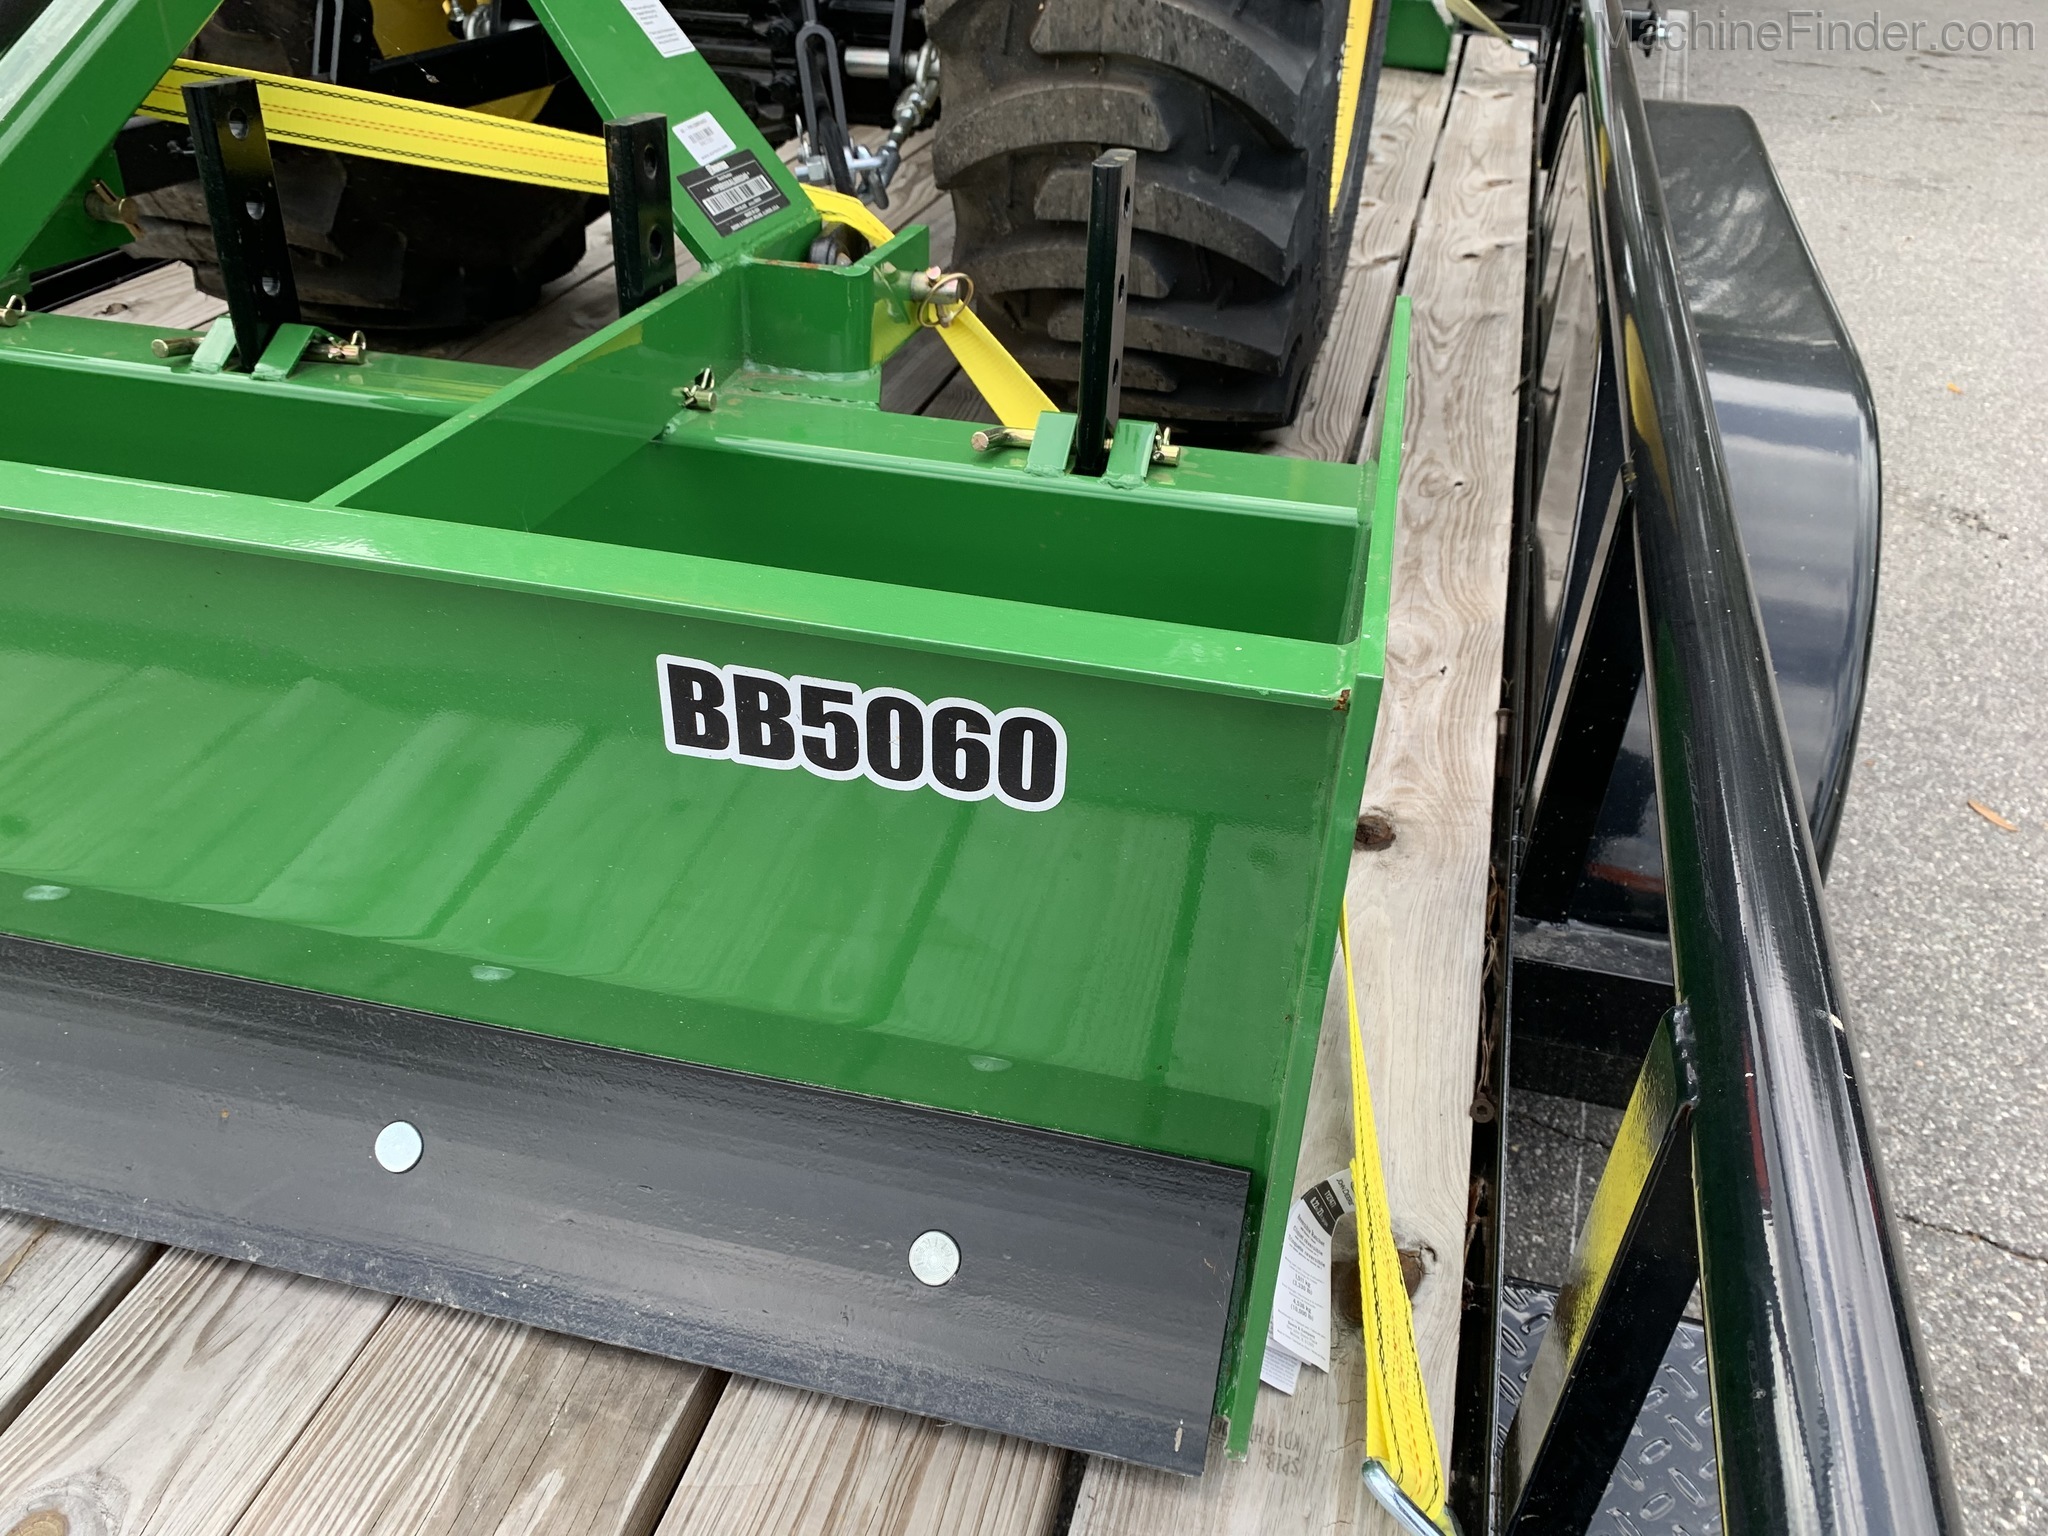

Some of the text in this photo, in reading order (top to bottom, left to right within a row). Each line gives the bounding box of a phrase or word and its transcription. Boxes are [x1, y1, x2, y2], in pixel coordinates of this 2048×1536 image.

[666, 663, 1057, 803] BB5060
[1336, 1178, 1355, 1206] JOHN DEERE
